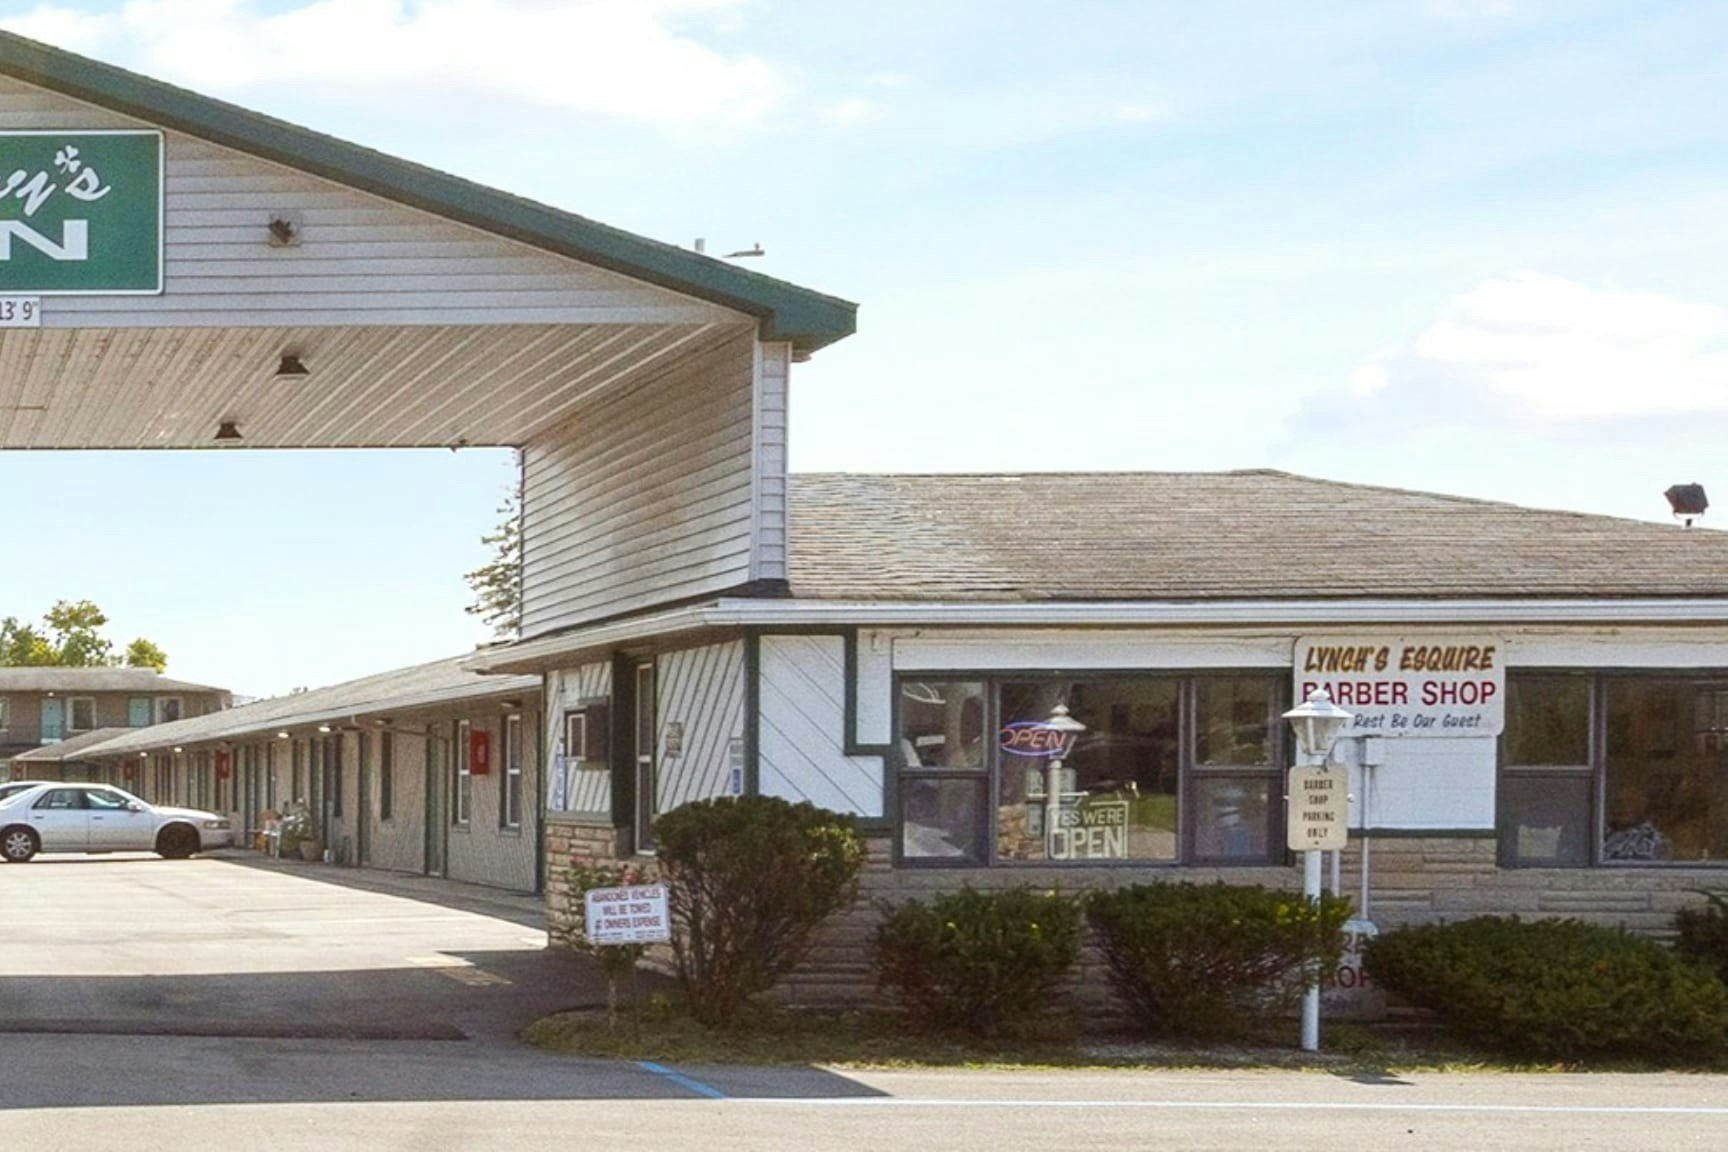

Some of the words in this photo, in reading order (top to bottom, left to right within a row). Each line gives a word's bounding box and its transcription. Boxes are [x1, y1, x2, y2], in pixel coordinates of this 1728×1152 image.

[1304, 645, 1390, 672] LYNCH'S
[1399, 645, 1496, 672] ESQUIRE
[1302, 681, 1409, 705] BARBER
[1421, 681, 1497, 705] SHOP
[1390, 713, 1408, 728] Be
[1413, 713, 1436, 728] Our
[1442, 713, 1481, 728] Guest
[1000, 728, 1067, 748] OPEN
[1303, 811, 1335, 822] PARKING
[1049, 826, 1124, 860] OPEN
